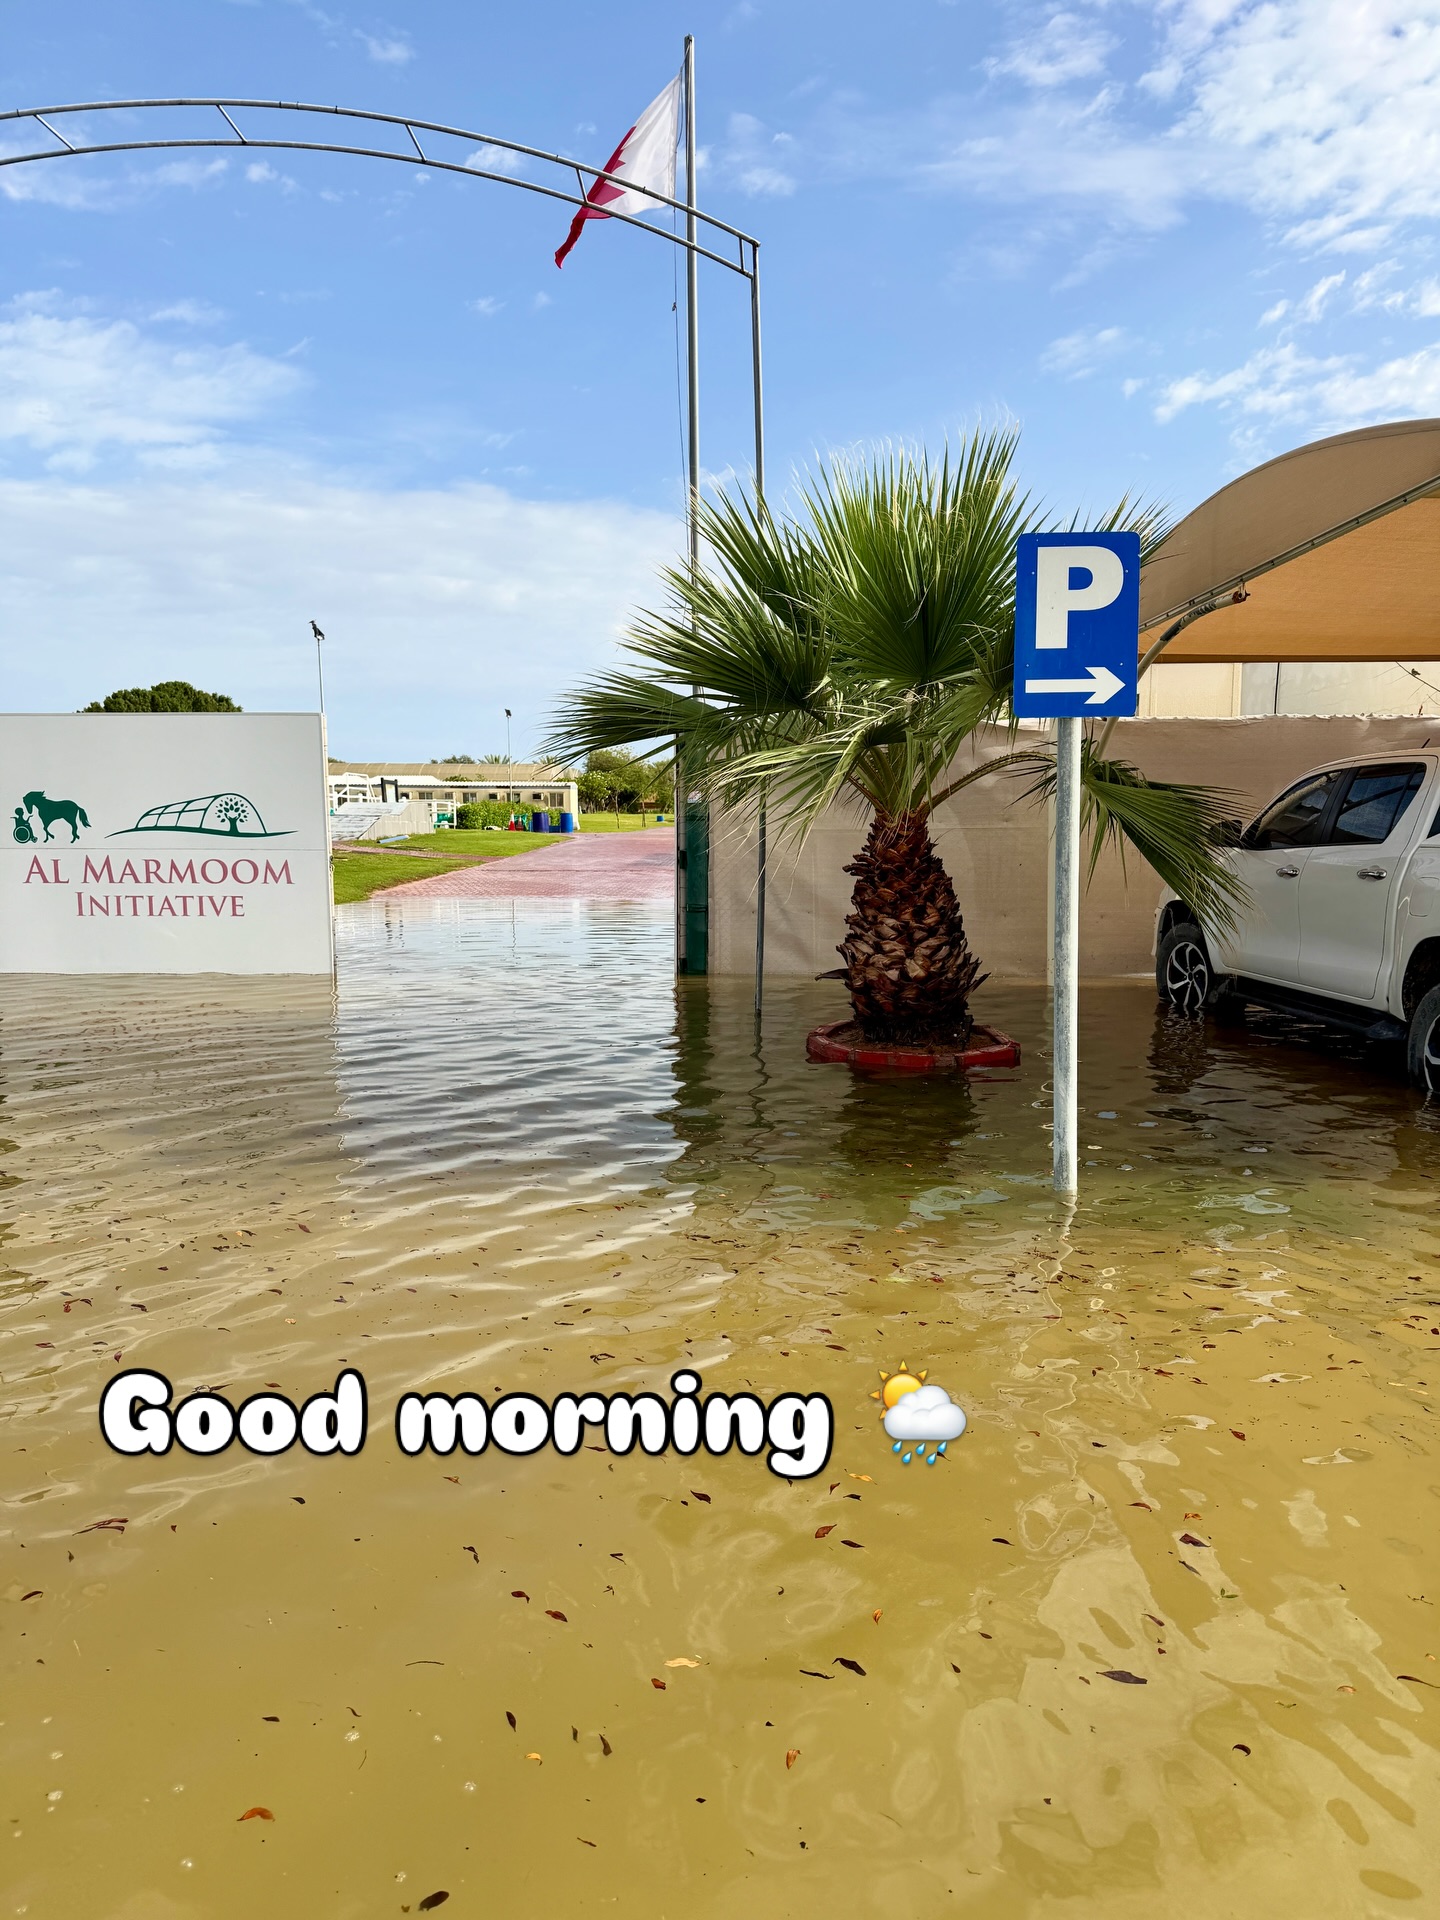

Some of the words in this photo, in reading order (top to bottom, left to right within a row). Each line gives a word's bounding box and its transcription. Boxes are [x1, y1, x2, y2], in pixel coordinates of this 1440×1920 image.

[1036, 546, 1124, 649] P
[23, 855, 69, 884] AL
[81, 855, 295, 884] MARMOOM
[76, 892, 246, 917] INITIATIVE
